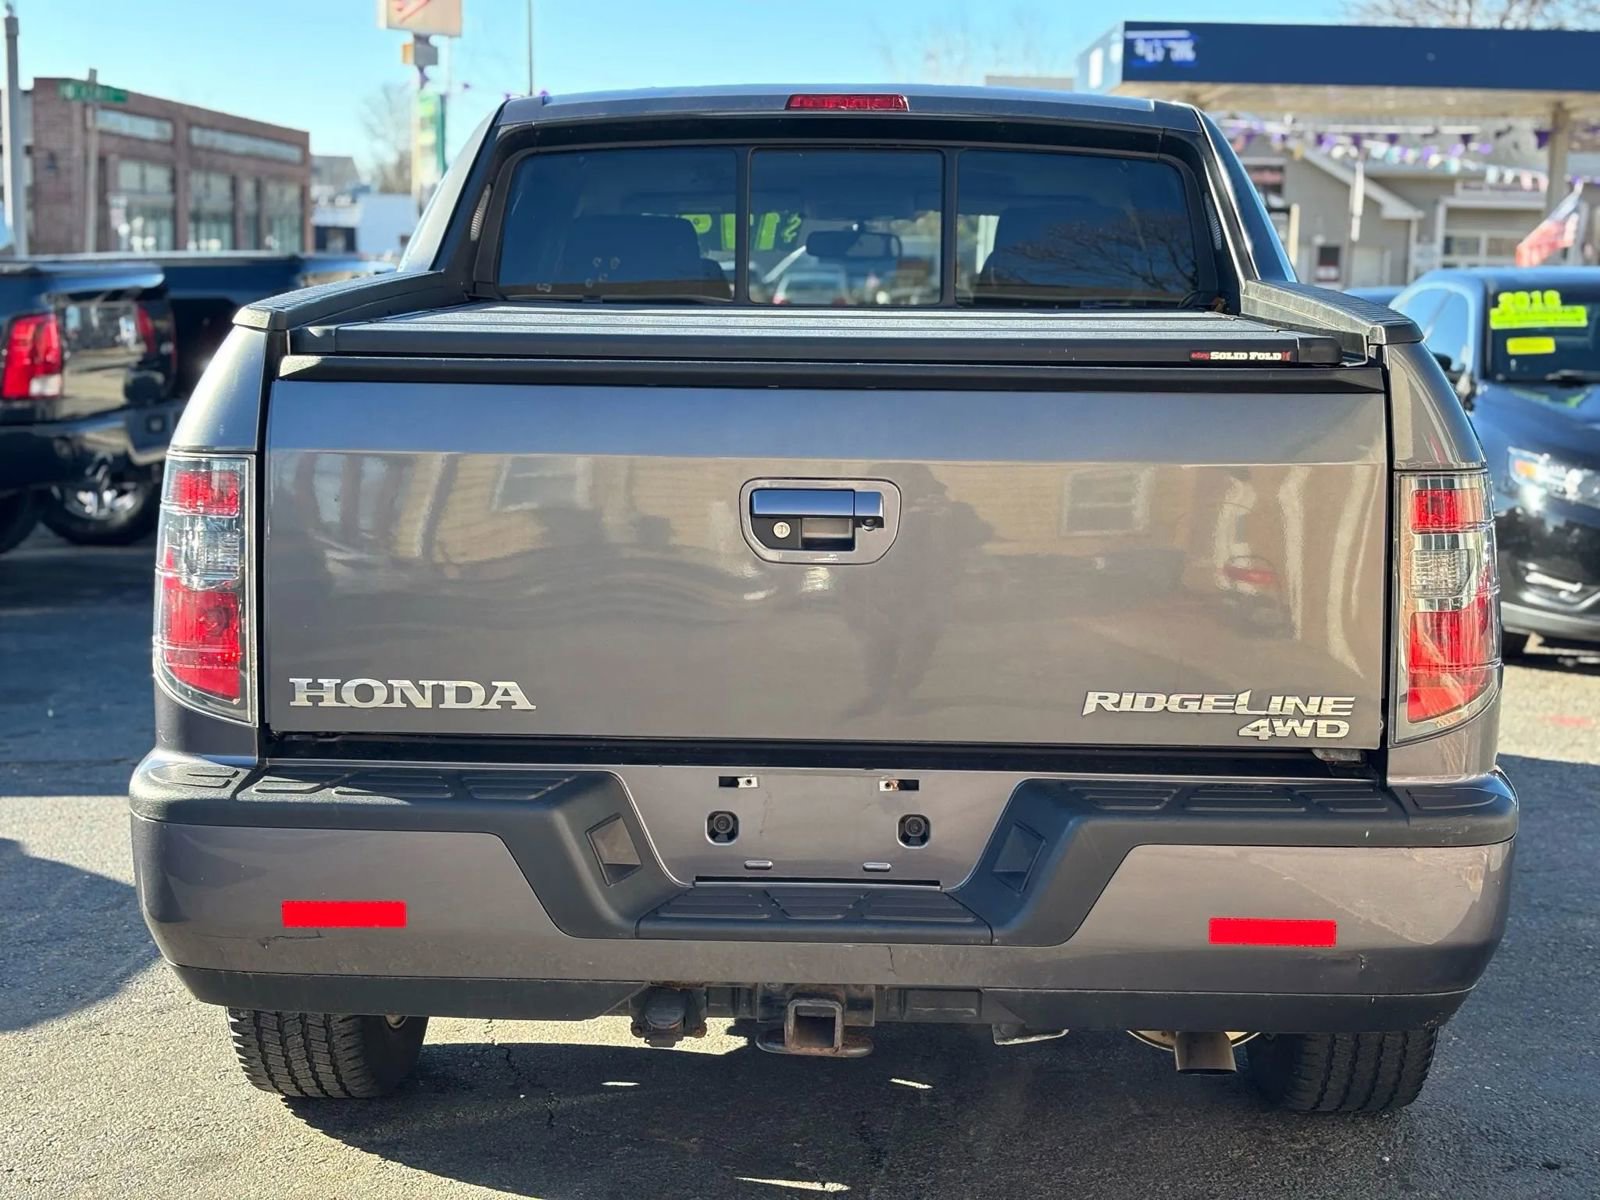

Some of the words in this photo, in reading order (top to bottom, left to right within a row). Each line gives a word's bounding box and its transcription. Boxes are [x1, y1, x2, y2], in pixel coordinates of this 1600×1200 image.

[1210, 351, 1248, 360] SOLID
[1249, 351, 1282, 360] FOLD
[289, 677, 537, 710] HONDA
[1082, 689, 1356, 716] RIDGELINE
[1238, 718, 1350, 741] 4WD
